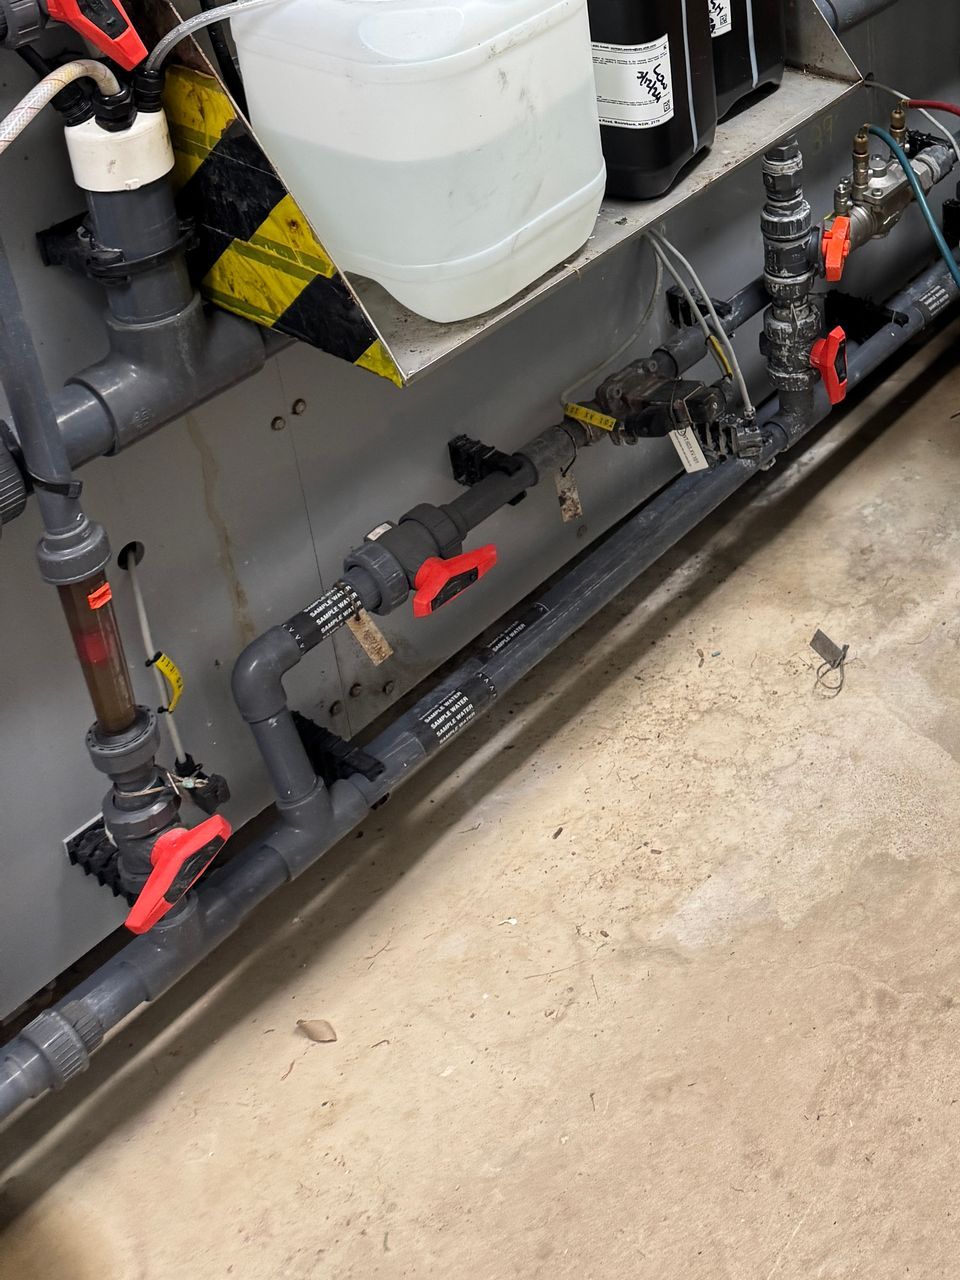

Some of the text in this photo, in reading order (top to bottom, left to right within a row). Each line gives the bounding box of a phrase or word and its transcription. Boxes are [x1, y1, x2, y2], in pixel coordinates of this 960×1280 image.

[310, 585, 352, 618] SAMPLE WATR
[316, 592, 358, 626] SAMPLE WATR
[321, 614, 344, 634] SAMPLE
[342, 600, 362, 617] WATR
[492, 635, 511, 652] SAMPLE
[509, 623, 526, 639] WATER
[430, 710, 452, 730] SAMPLE
[451, 696, 469, 713] WATER
[436, 718, 457, 737] SAMPLE
[456, 703, 474, 720] WATER
